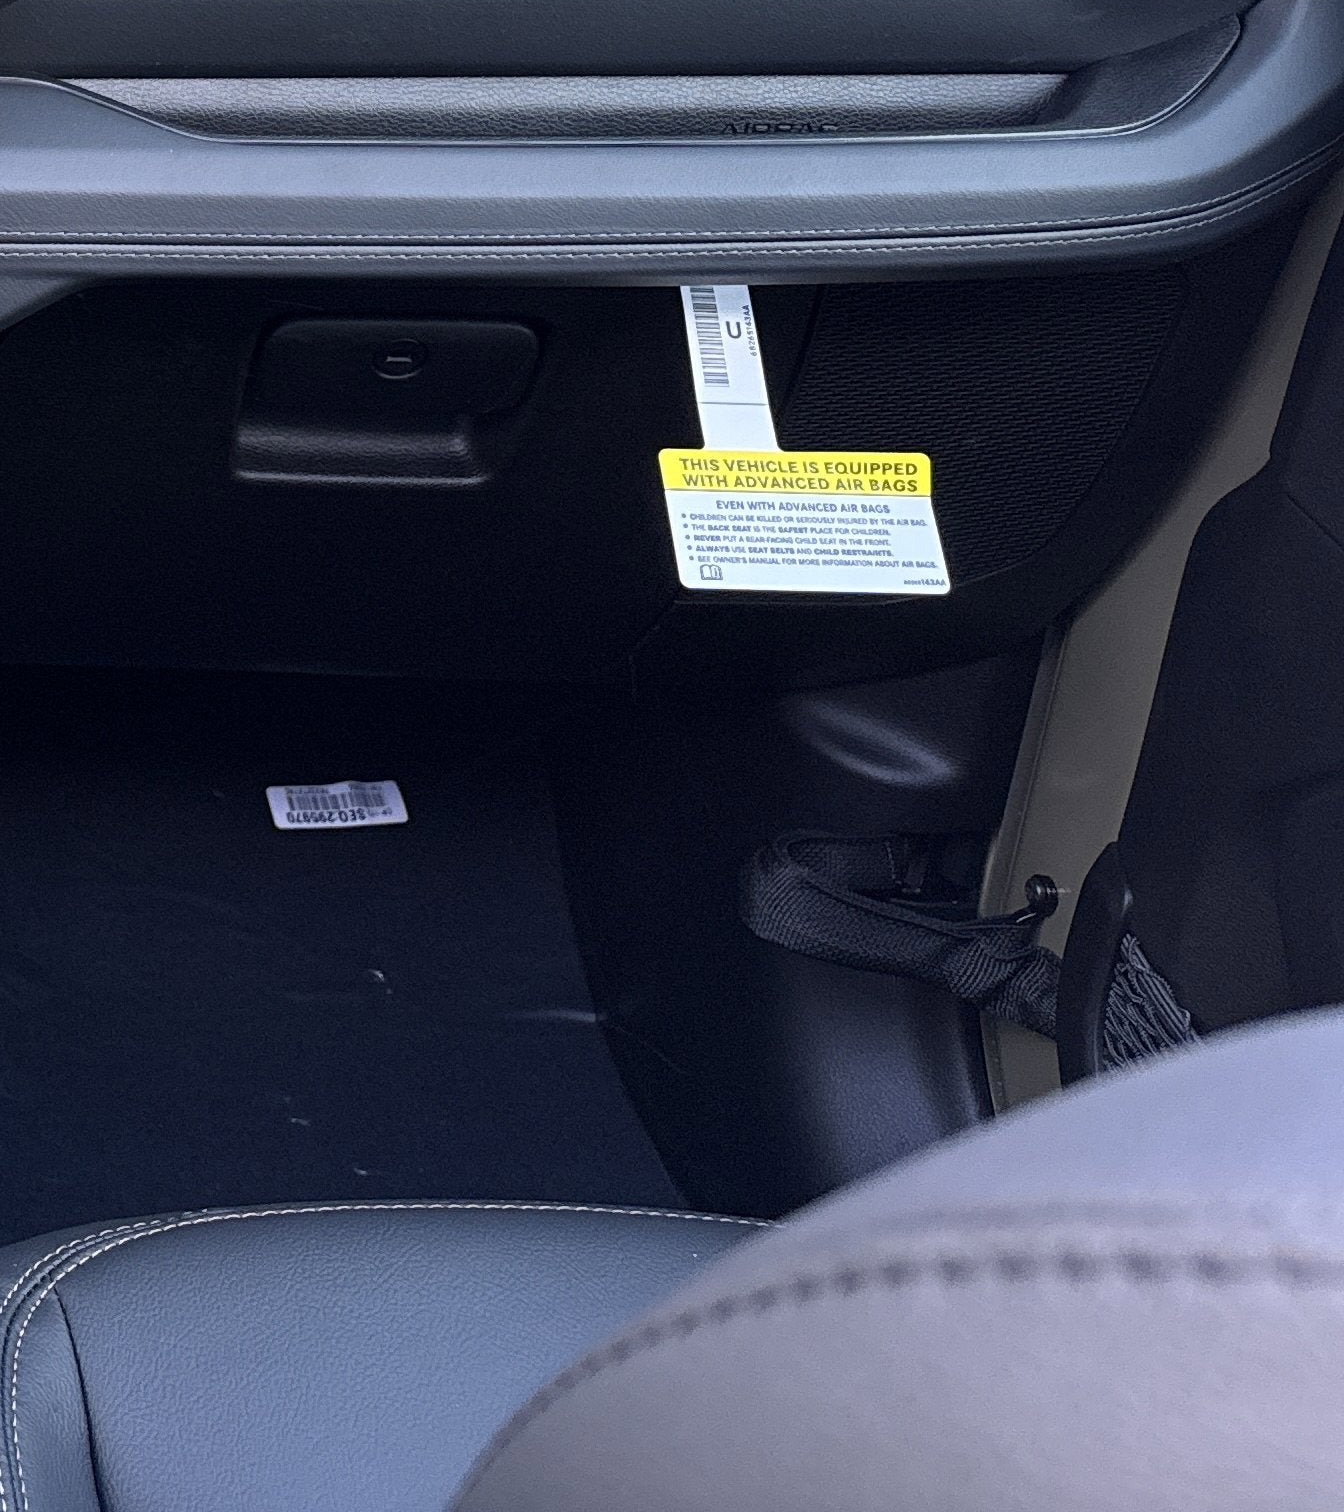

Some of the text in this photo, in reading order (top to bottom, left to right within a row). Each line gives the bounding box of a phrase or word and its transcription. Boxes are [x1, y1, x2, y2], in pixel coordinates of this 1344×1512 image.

[726, 321, 743, 340] U
[679, 458, 918, 475] THIS VEHICLE IS EQUIPPED
[682, 474, 918, 492] WITH ADVANCED AIR BAGS
[716, 500, 891, 514] EVEN WITH ADVANCED AIR BAGS
[690, 513, 727, 521] CHILDREN
[728, 514, 744, 522] CAN
[691, 523, 706, 531] THE
[707, 524, 730, 532] BACK
[810, 527, 833, 535] PLACE
[693, 534, 721, 542] NEVER
[795, 537, 817, 545] CHILD
[696, 545, 730, 553] ALWAYS
[748, 546, 768, 554] SEAT
[770, 547, 795, 555] BELTS
[698, 555, 711, 563] SEE
[749, 557, 780, 565] MANUAL
[782, 557, 797, 565] FOR
[799, 558, 820, 566] MORE
[822, 559, 873, 567] INFORMATION
[902, 560, 914, 568] AIR
